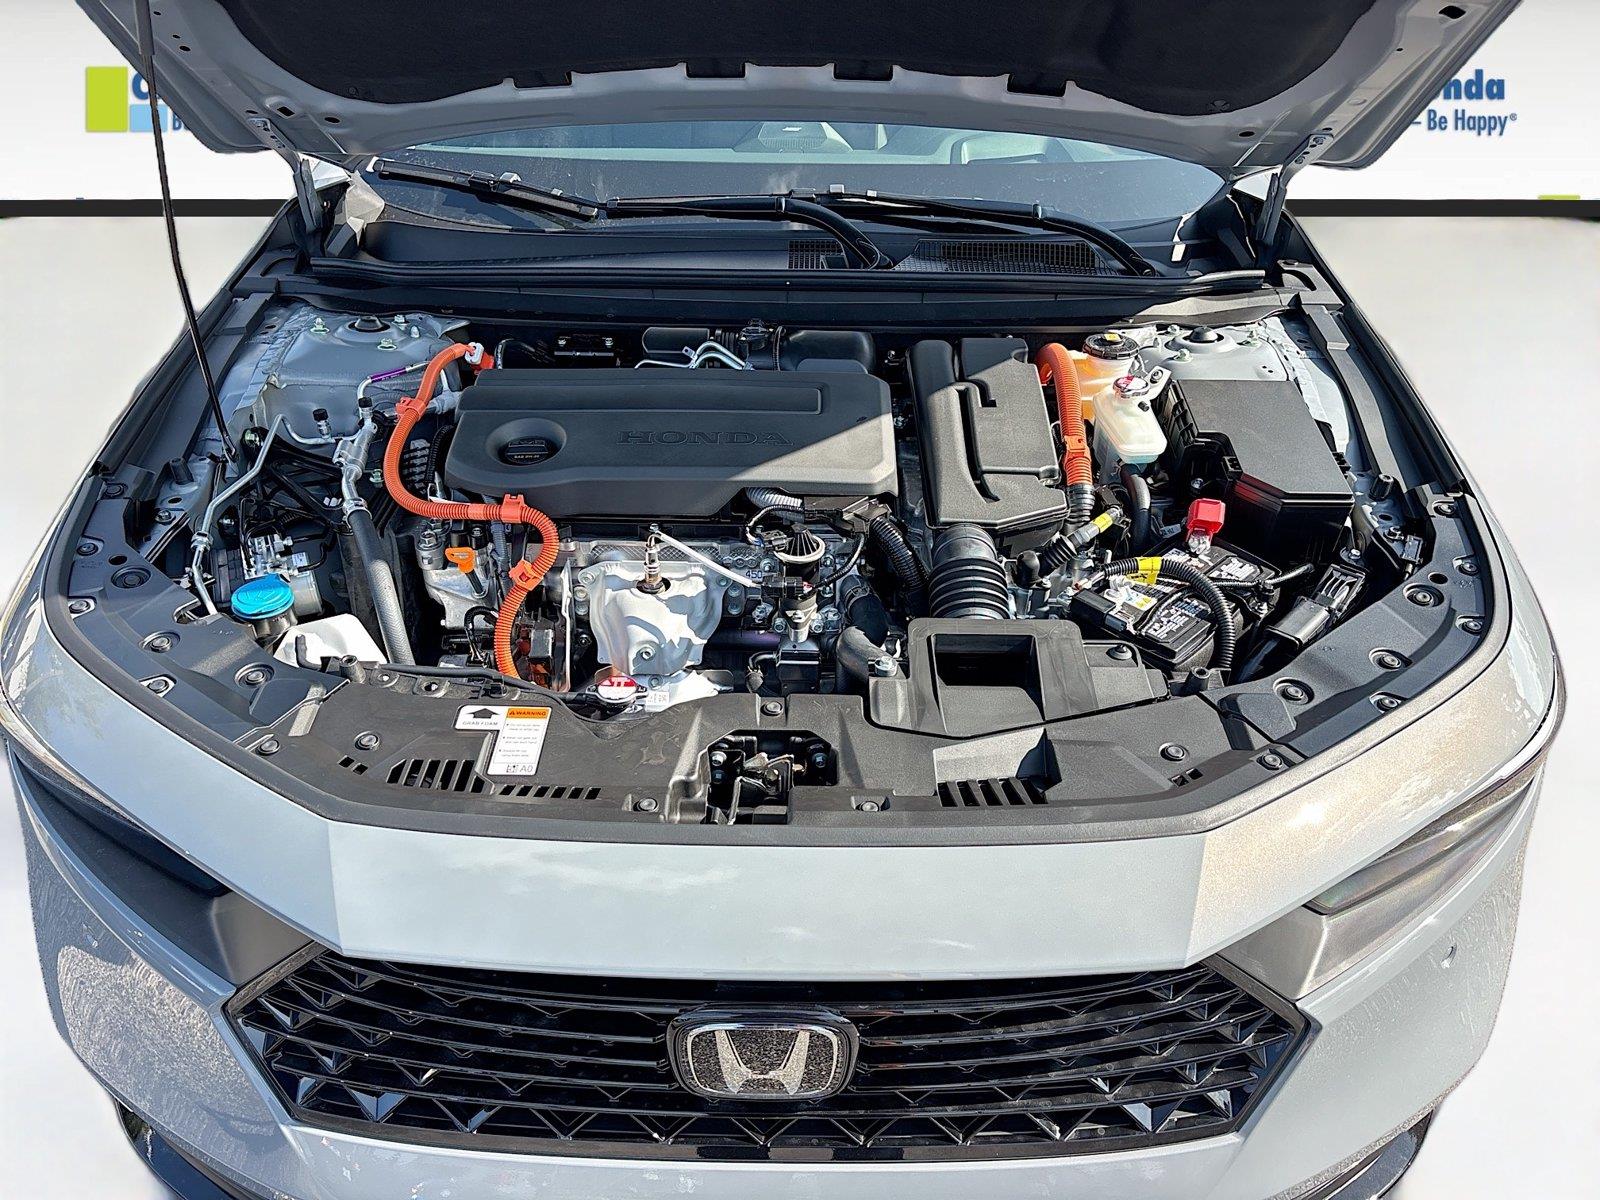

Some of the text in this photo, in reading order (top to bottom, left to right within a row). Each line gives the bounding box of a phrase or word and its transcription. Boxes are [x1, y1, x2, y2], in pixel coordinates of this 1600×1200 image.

[1443, 69, 1505, 100] nda
[1427, 109, 1448, 131] Be
[616, 430, 794, 446] HONDA
